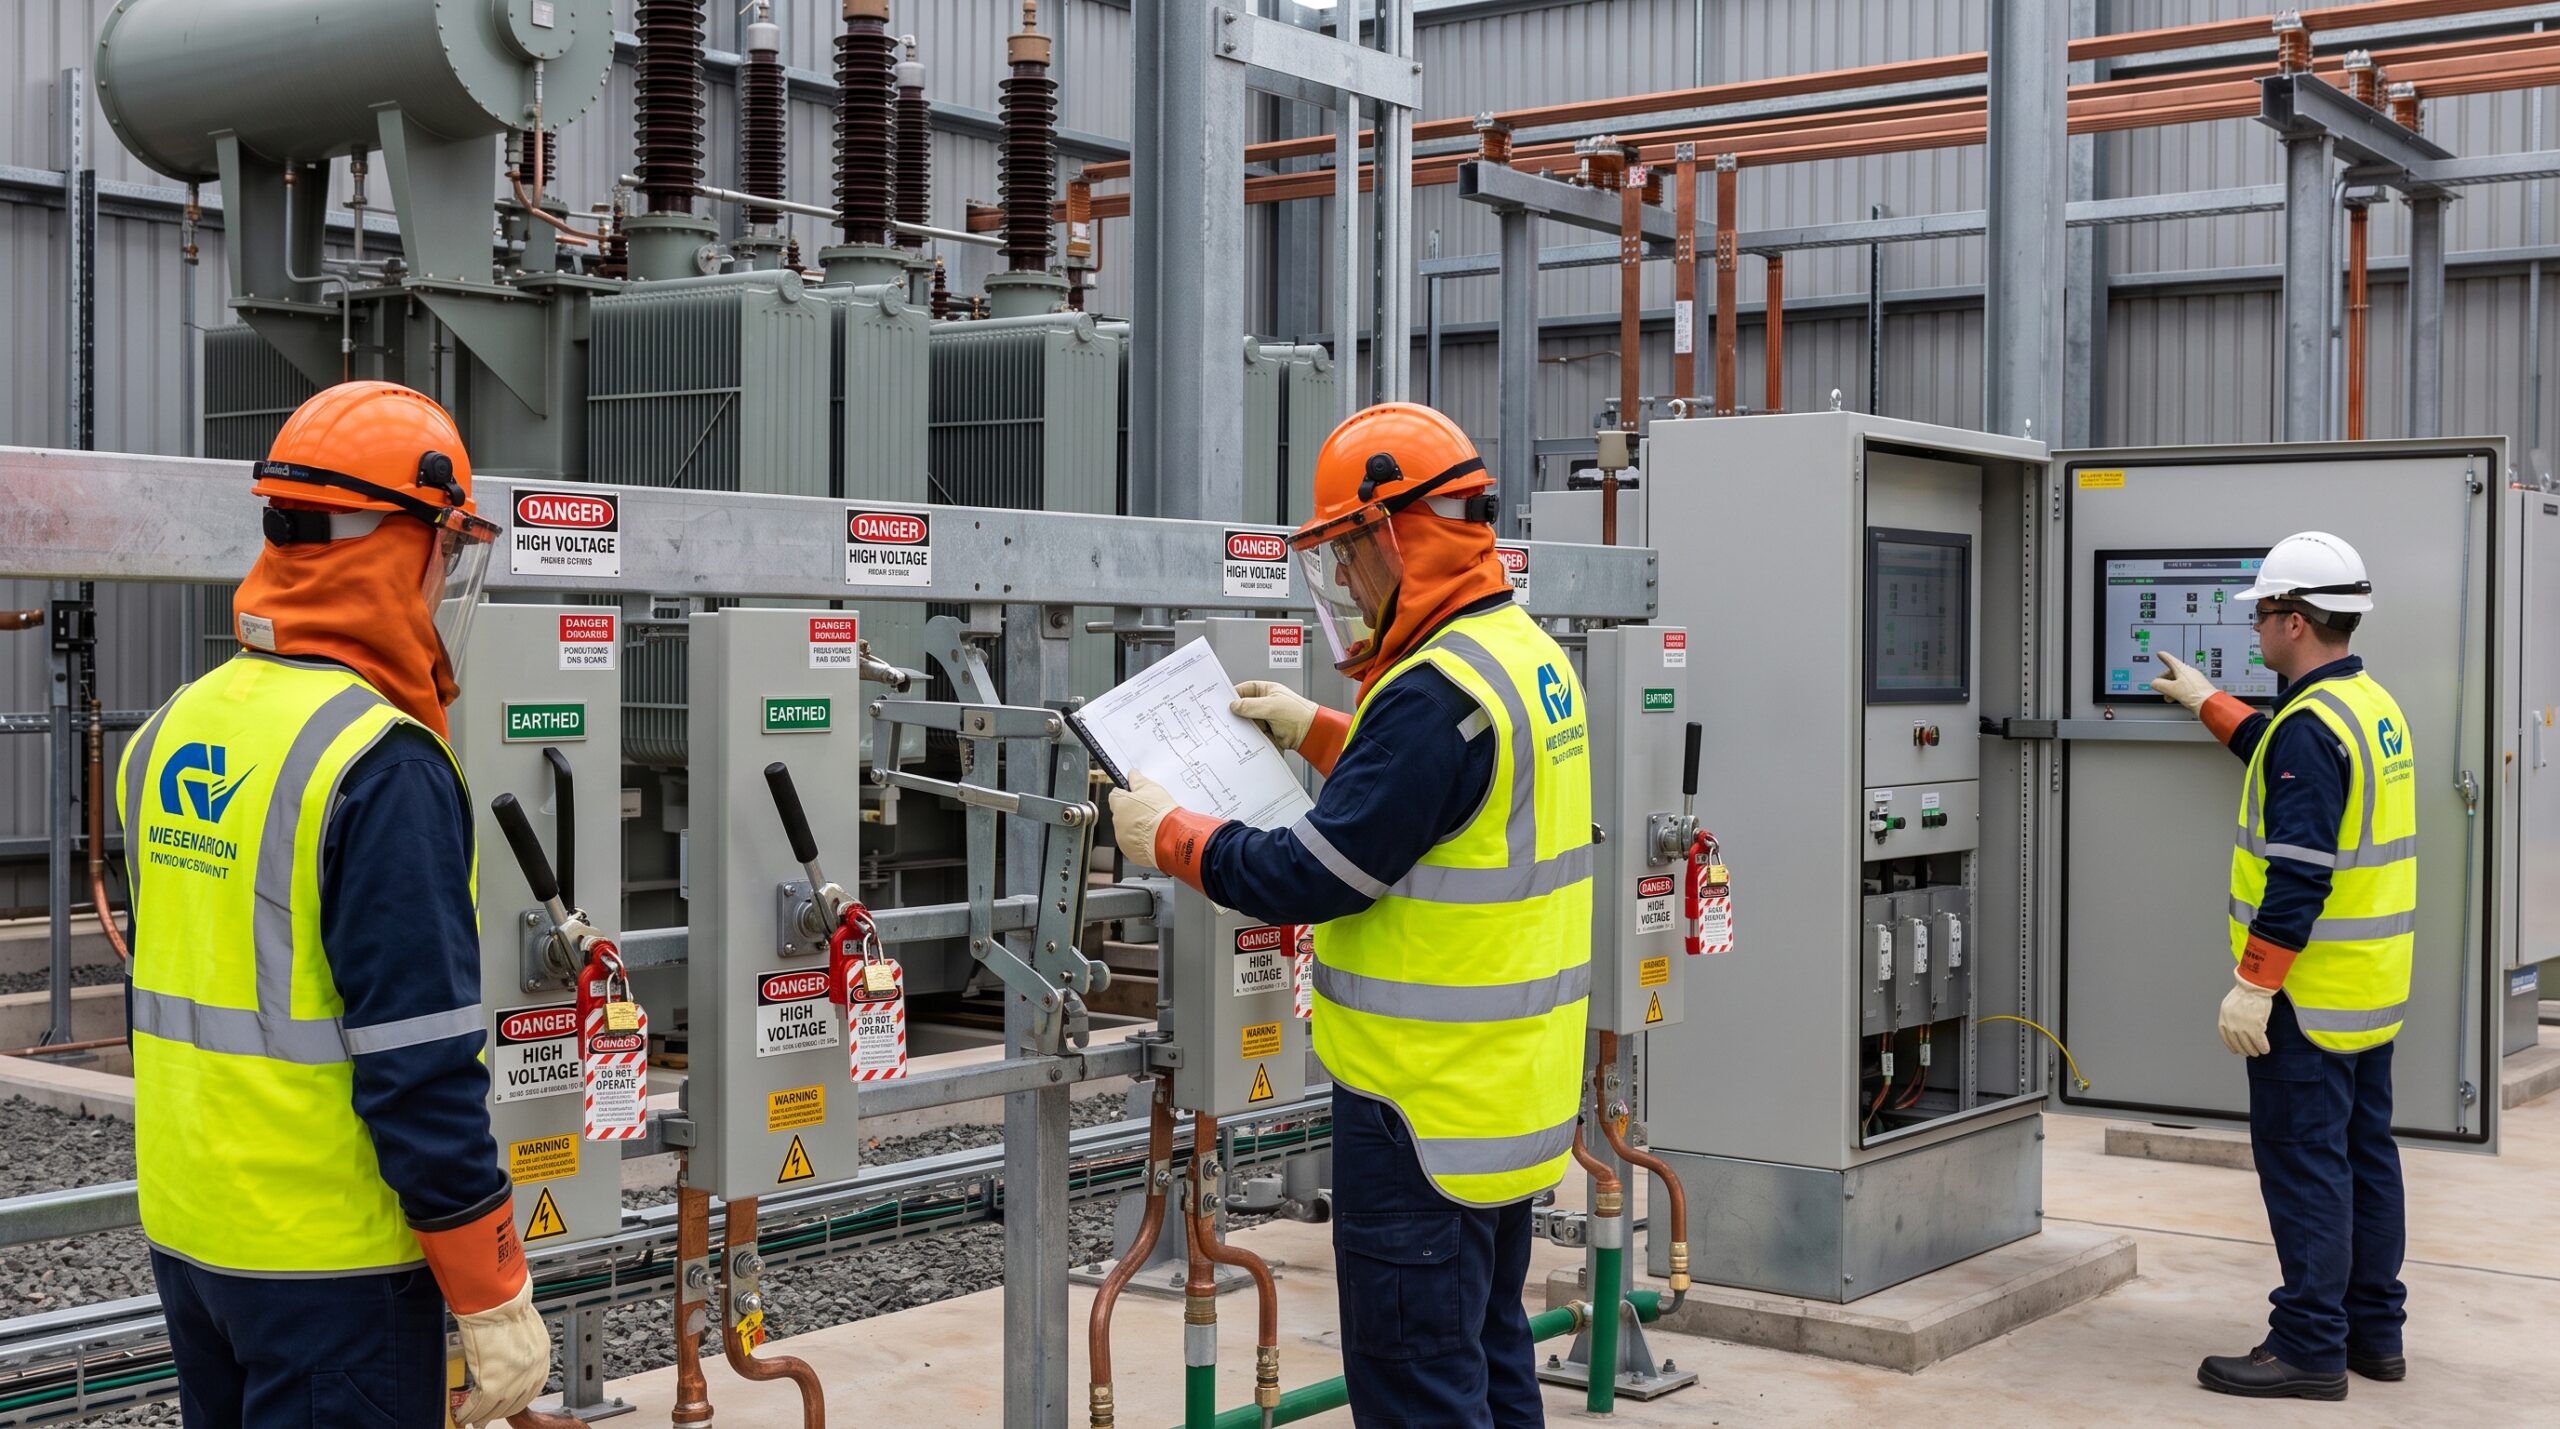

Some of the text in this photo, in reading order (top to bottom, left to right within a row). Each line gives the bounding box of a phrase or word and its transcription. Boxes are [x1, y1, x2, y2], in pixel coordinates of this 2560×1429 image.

[528, 500, 604, 522] DANGER
[858, 519, 918, 538] DANGER
[516, 534, 615, 553] HIGH VOLTAGE
[1234, 539, 1280, 556] DANGER
[849, 549, 927, 566] HIGH VOLTAGE
[1226, 565, 1286, 580] HIGH VOLTAGE
[566, 619, 608, 628] DANGER
[815, 621, 851, 630] DANGER
[511, 712, 580, 730] EARTHED
[769, 706, 826, 721] EARTHED
[1242, 930, 1280, 947] DANGER
[1249, 954, 1273, 968] HIGH
[1241, 967, 1282, 985] VOLTAGE
[769, 976, 825, 997] DANGER
[780, 1004, 813, 1022] HIGH
[510, 1013, 577, 1036] DANGER
[767, 1020, 827, 1042] VOLTAGE
[858, 1024, 895, 1036] OPERATE
[523, 1044, 562, 1064] HIGH
[508, 1061, 579, 1087] VOLTAGE
[596, 1078, 636, 1091] OPERATE
[774, 1089, 818, 1106] WARNING
[518, 1137, 570, 1156] WARNING
